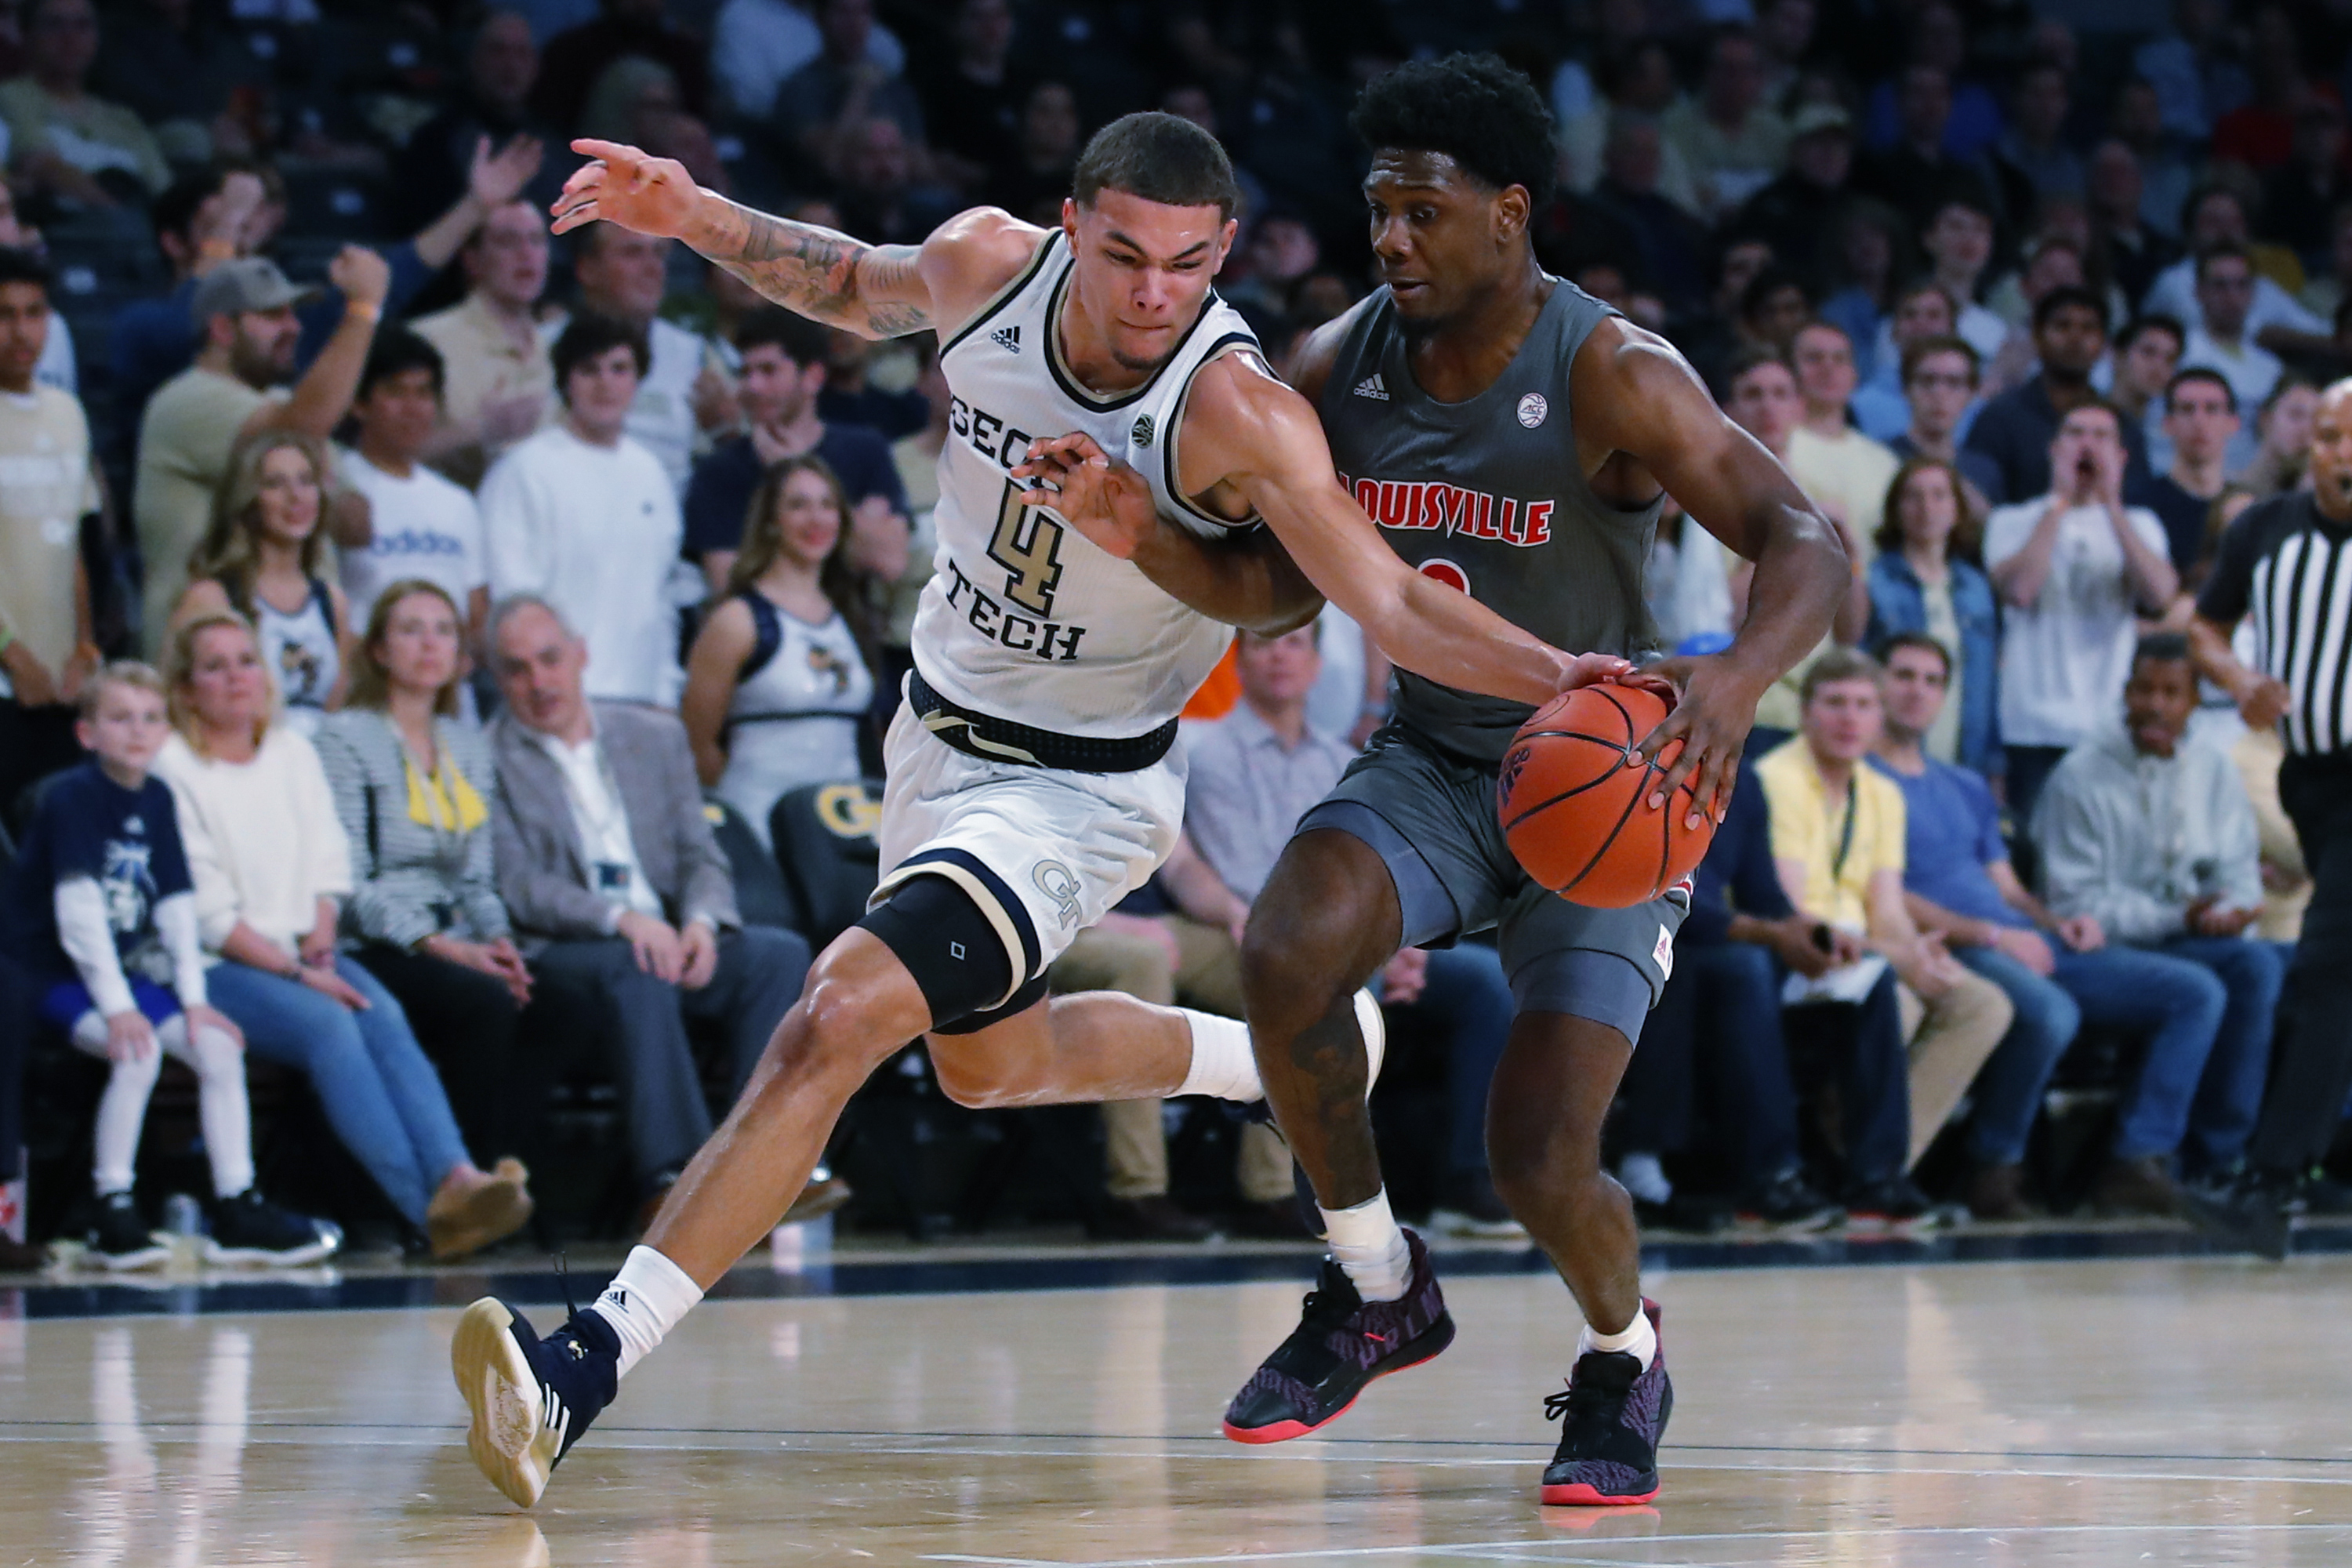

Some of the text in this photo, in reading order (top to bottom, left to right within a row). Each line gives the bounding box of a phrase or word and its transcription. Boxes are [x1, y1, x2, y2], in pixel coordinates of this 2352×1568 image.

[990, 332, 1021, 354] adidas
[1353, 387, 1390, 401] adidas
[1521, 404, 1545, 414] ACC
[986, 477, 1064, 619] 4
[946, 557, 1087, 661] TECH
[1032, 858, 1083, 931] GT
